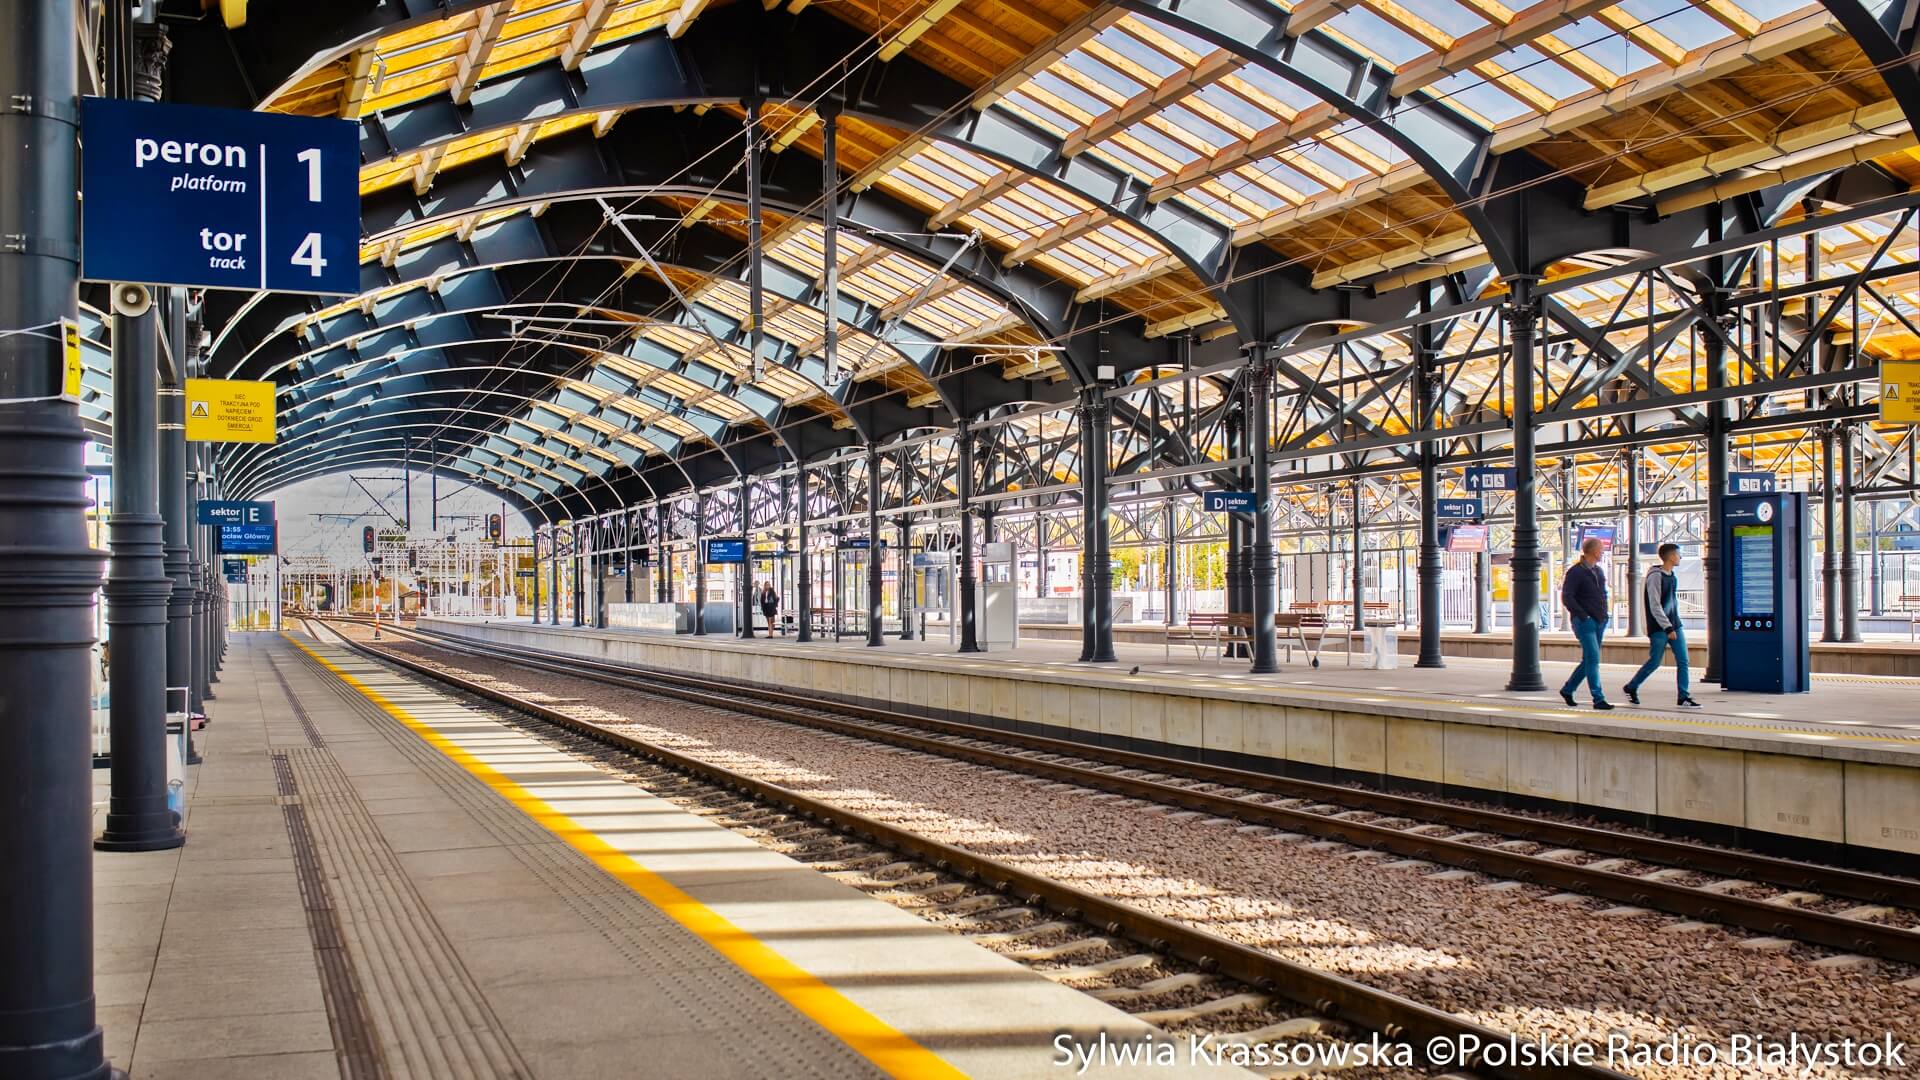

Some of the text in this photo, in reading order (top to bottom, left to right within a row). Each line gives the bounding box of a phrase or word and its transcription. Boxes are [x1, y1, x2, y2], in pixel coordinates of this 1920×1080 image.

[135, 138, 322, 203] peron 1
[171, 173, 246, 193] platform
[199, 227, 328, 277] tor 4
[209, 255, 246, 270] track
[1214, 497, 1248, 510] D sektor
[1443, 503, 1475, 515] sektor D
[210, 507, 260, 522] sektor E
